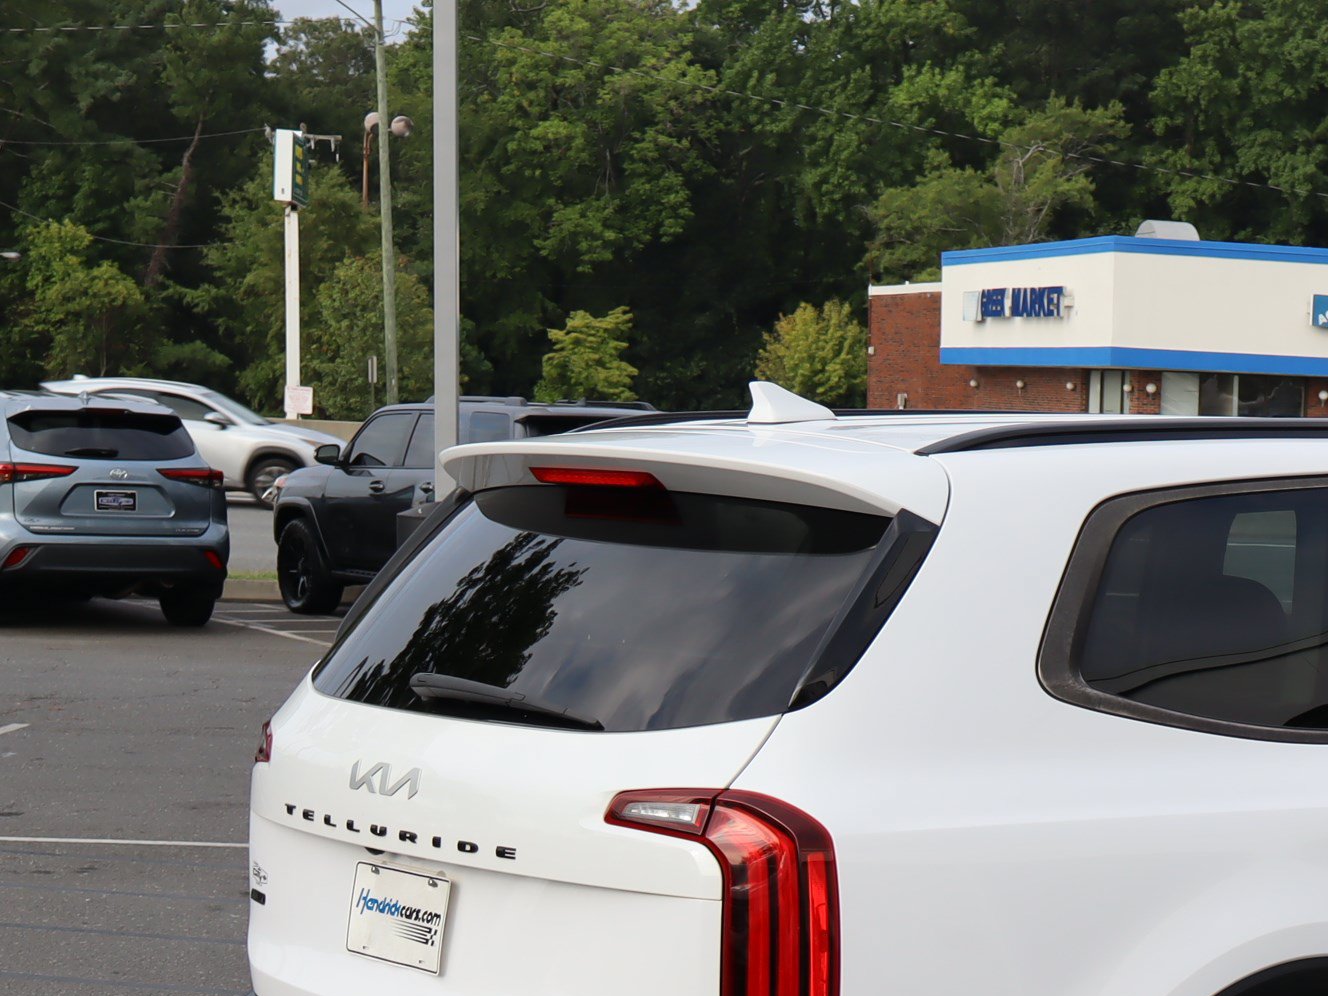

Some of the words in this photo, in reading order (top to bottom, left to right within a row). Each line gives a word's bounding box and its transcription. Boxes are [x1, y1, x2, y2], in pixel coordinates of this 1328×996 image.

[1012, 286, 1064, 317] MARKET
[349, 759, 422, 800] KIA
[285, 803, 517, 860] TELLURIDE
[356, 887, 441, 926] Hendrickcars.com
